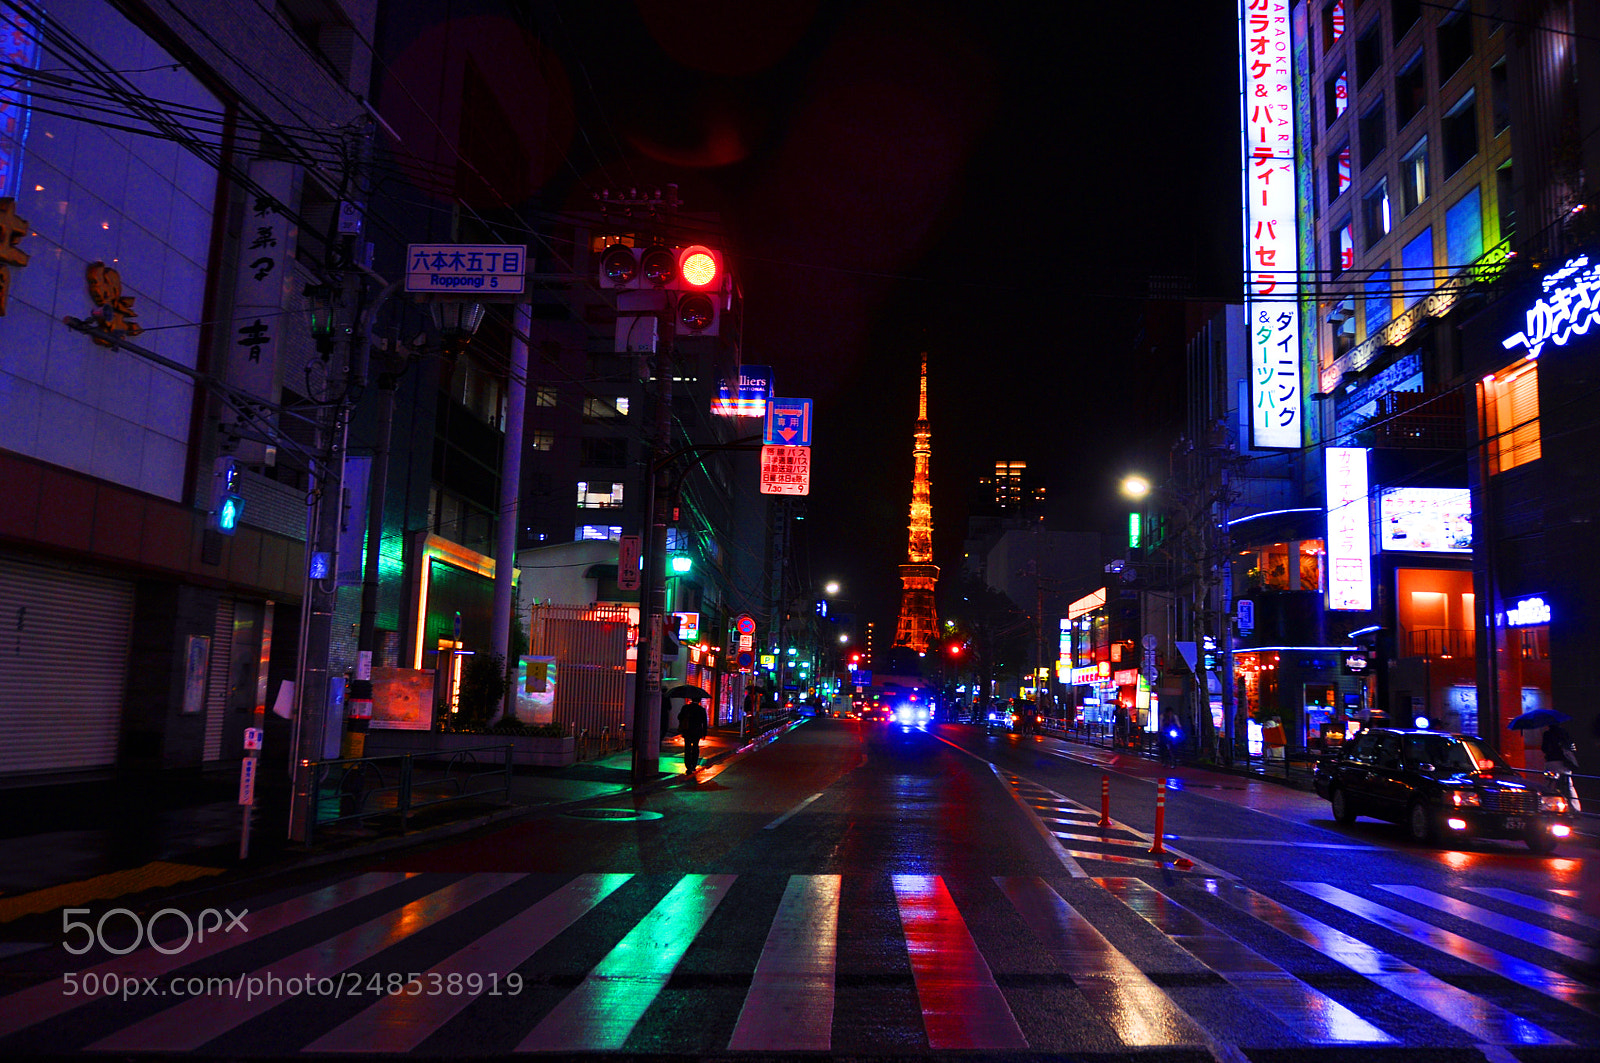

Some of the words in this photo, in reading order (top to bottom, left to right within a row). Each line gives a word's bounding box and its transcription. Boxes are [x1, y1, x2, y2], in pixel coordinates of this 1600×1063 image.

[1277, 104, 1290, 172] PARTY
[412, 250, 519, 273] 六本木五丁目
[1254, 219, 1277, 294] パセラ
[431, 274, 485, 288] Roppongi
[490, 277, 498, 288] 5
[1276, 311, 1297, 427] ダイニング
[798, 485, 804, 494] 9
